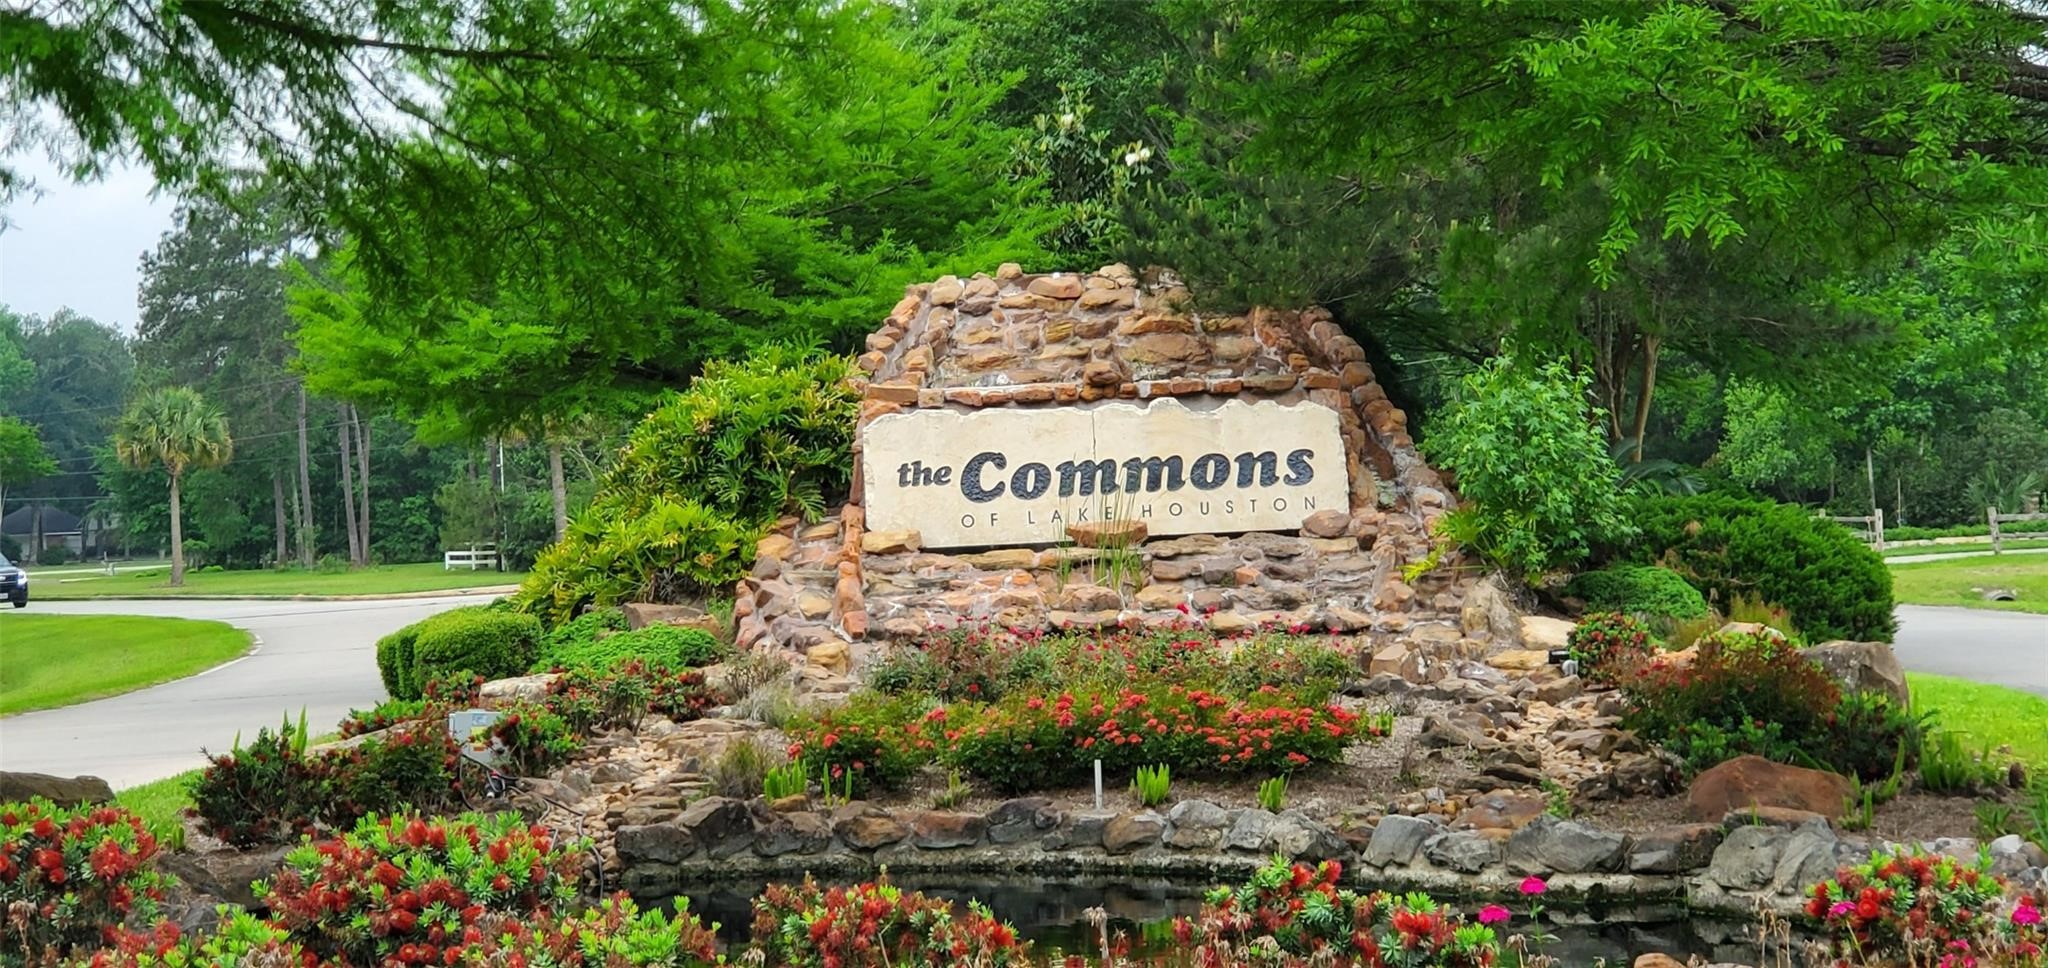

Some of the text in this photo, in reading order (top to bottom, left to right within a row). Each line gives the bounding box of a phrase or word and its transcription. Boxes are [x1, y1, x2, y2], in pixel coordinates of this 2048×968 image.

[897, 448, 1314, 503] the Commons
[961, 496, 1316, 528] OF LAKE HOUSTON
